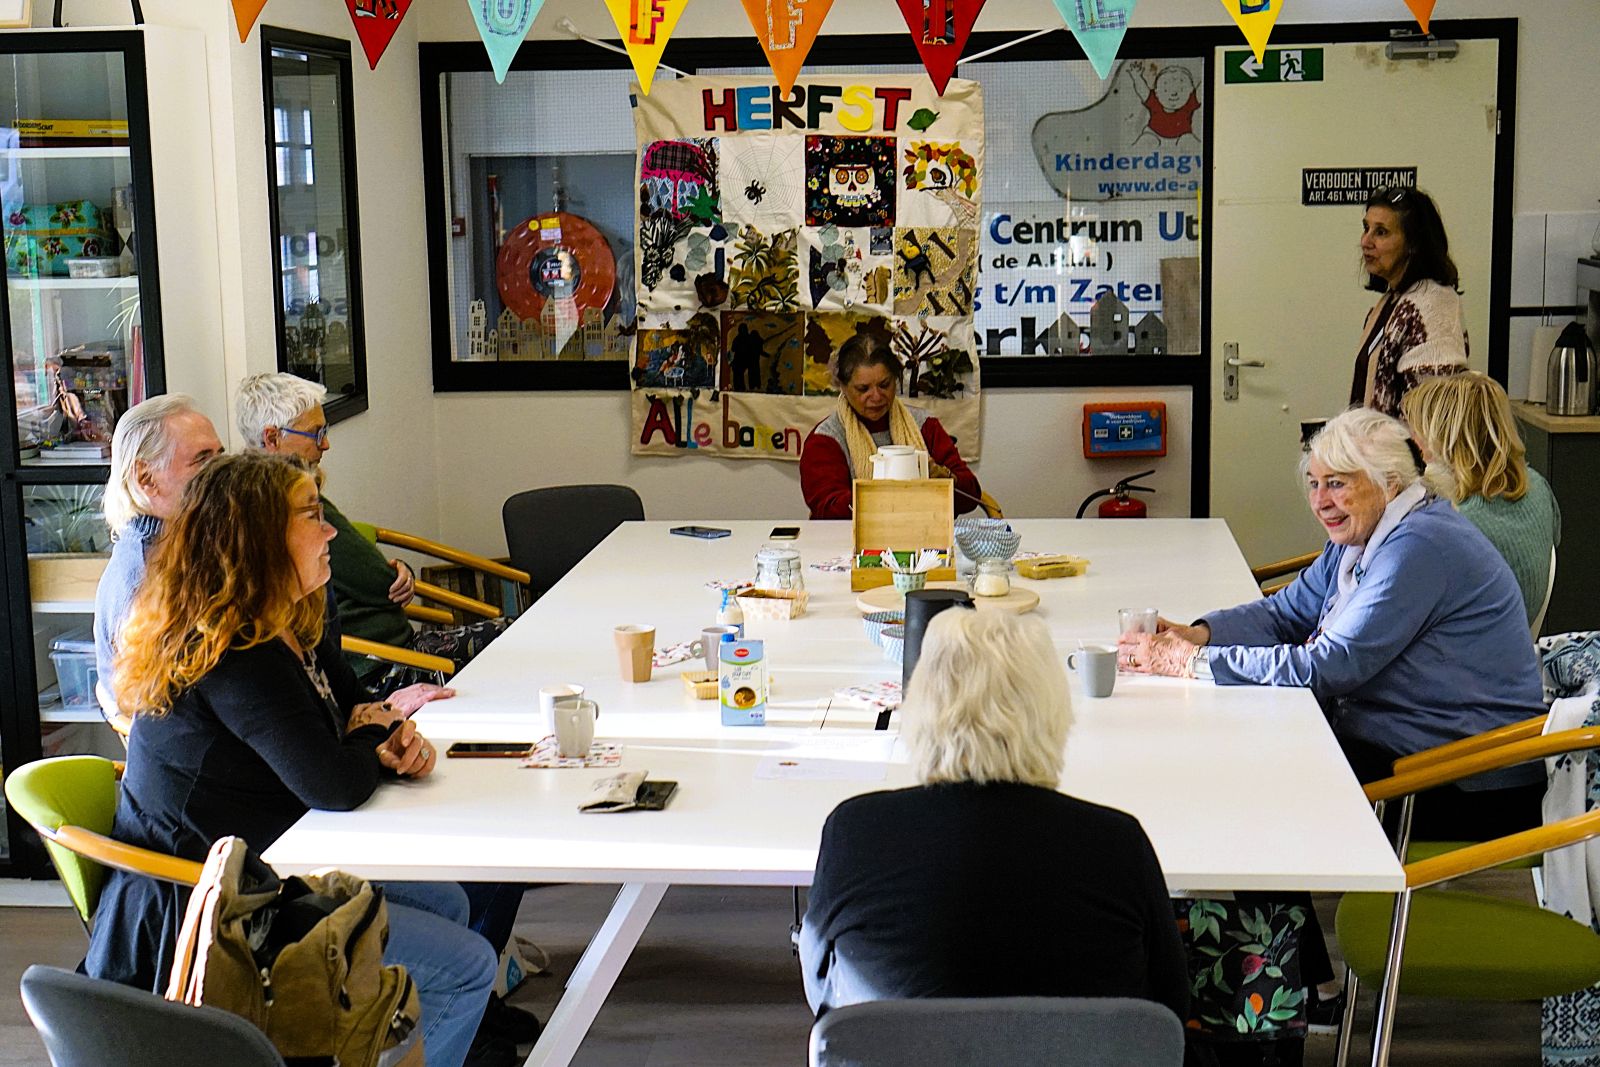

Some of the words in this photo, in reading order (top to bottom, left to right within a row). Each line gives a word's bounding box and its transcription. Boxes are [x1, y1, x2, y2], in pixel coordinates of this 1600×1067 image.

[702, 85, 912, 132] HERFST
[1305, 172, 1362, 189] VERBODEN
[989, 214, 1143, 245] Centrum
[992, 254, 1018, 269] de
[995, 279, 1056, 306] t/m
